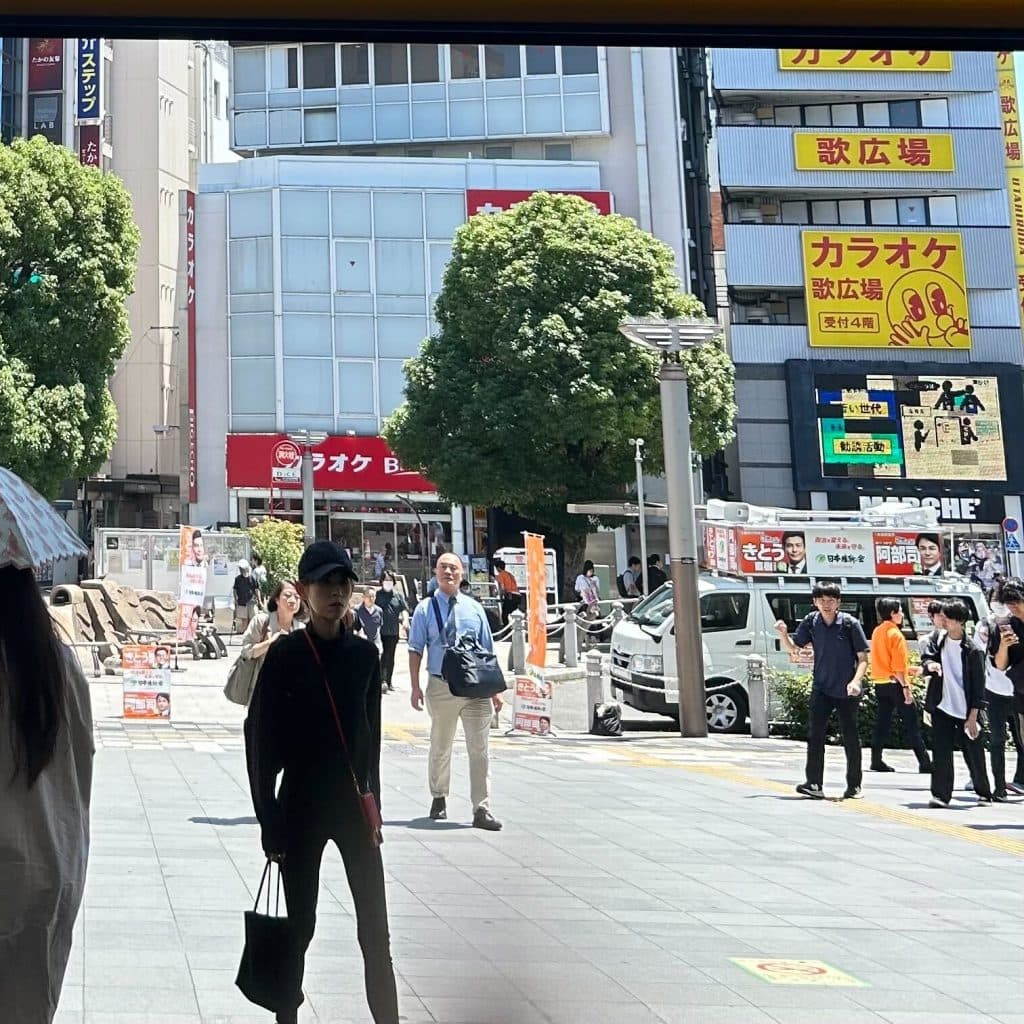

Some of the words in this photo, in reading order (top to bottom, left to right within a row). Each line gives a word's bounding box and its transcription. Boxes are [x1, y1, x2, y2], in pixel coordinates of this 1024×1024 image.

[33, 121, 56, 130] LAB
[999, 95, 1022, 161] 歌広場
[816, 137, 932, 166] 歌広場
[187, 206, 195, 305] カラオケ
[811, 236, 956, 269] カラオケ
[812, 278, 884, 301] 歌広場
[824, 316, 875, 329] 受付4階
[859, 495, 977, 520] MRCHE
[742, 542, 785, 561] きとう
[876, 545, 921, 564] 阿部司
